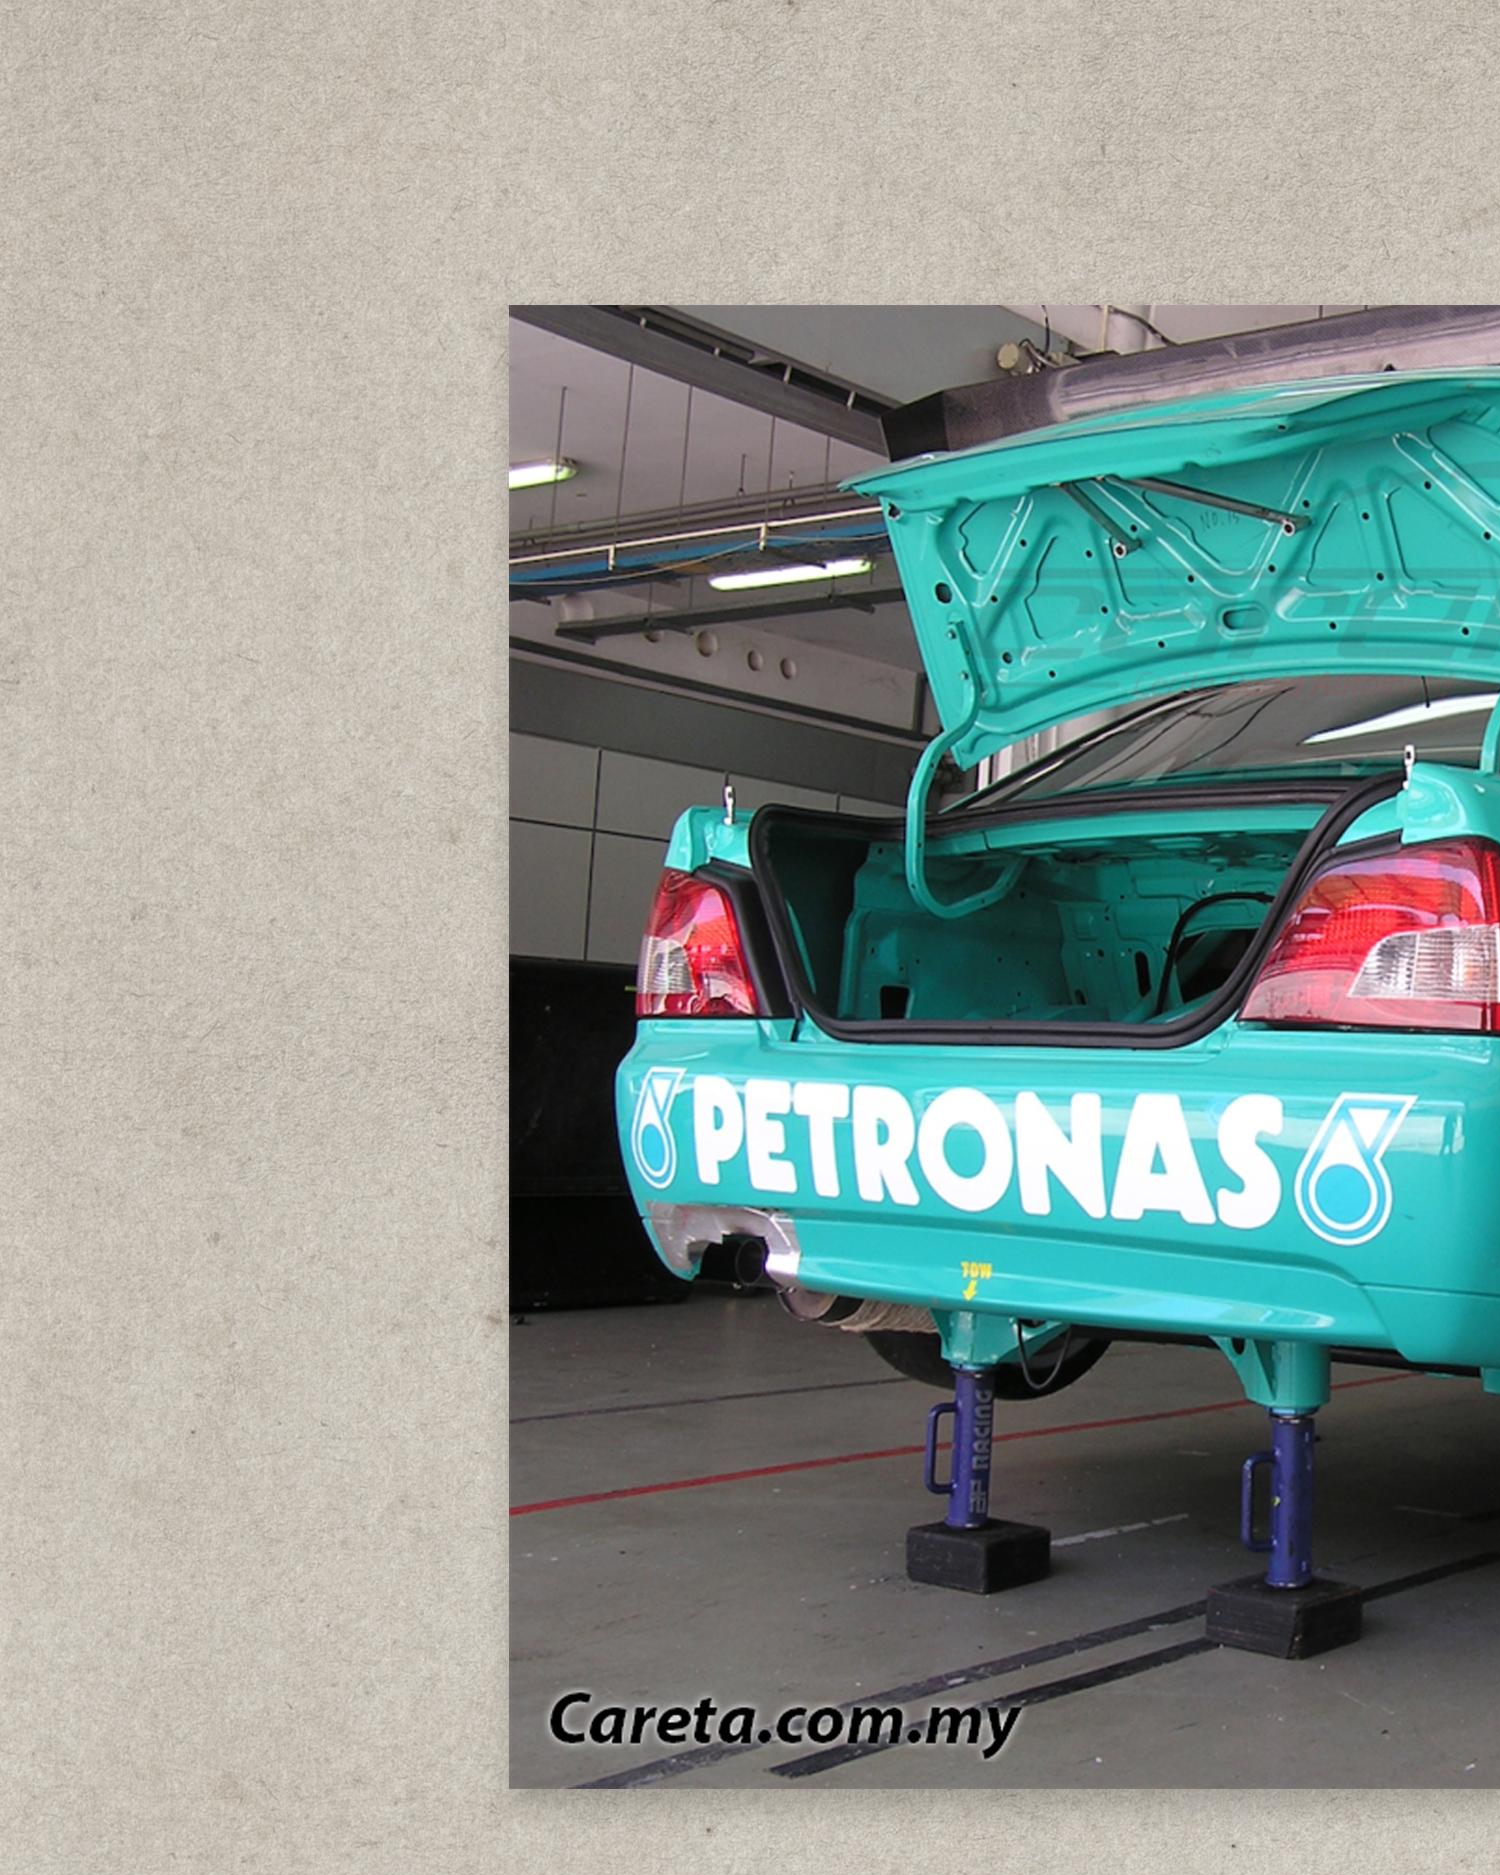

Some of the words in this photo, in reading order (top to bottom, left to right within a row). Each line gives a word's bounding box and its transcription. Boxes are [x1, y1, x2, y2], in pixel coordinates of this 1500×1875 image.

[690, 1075, 1283, 1230] PETRONAS
[960, 1261, 993, 1280] TOW
[972, 1388, 994, 1470] RACING
